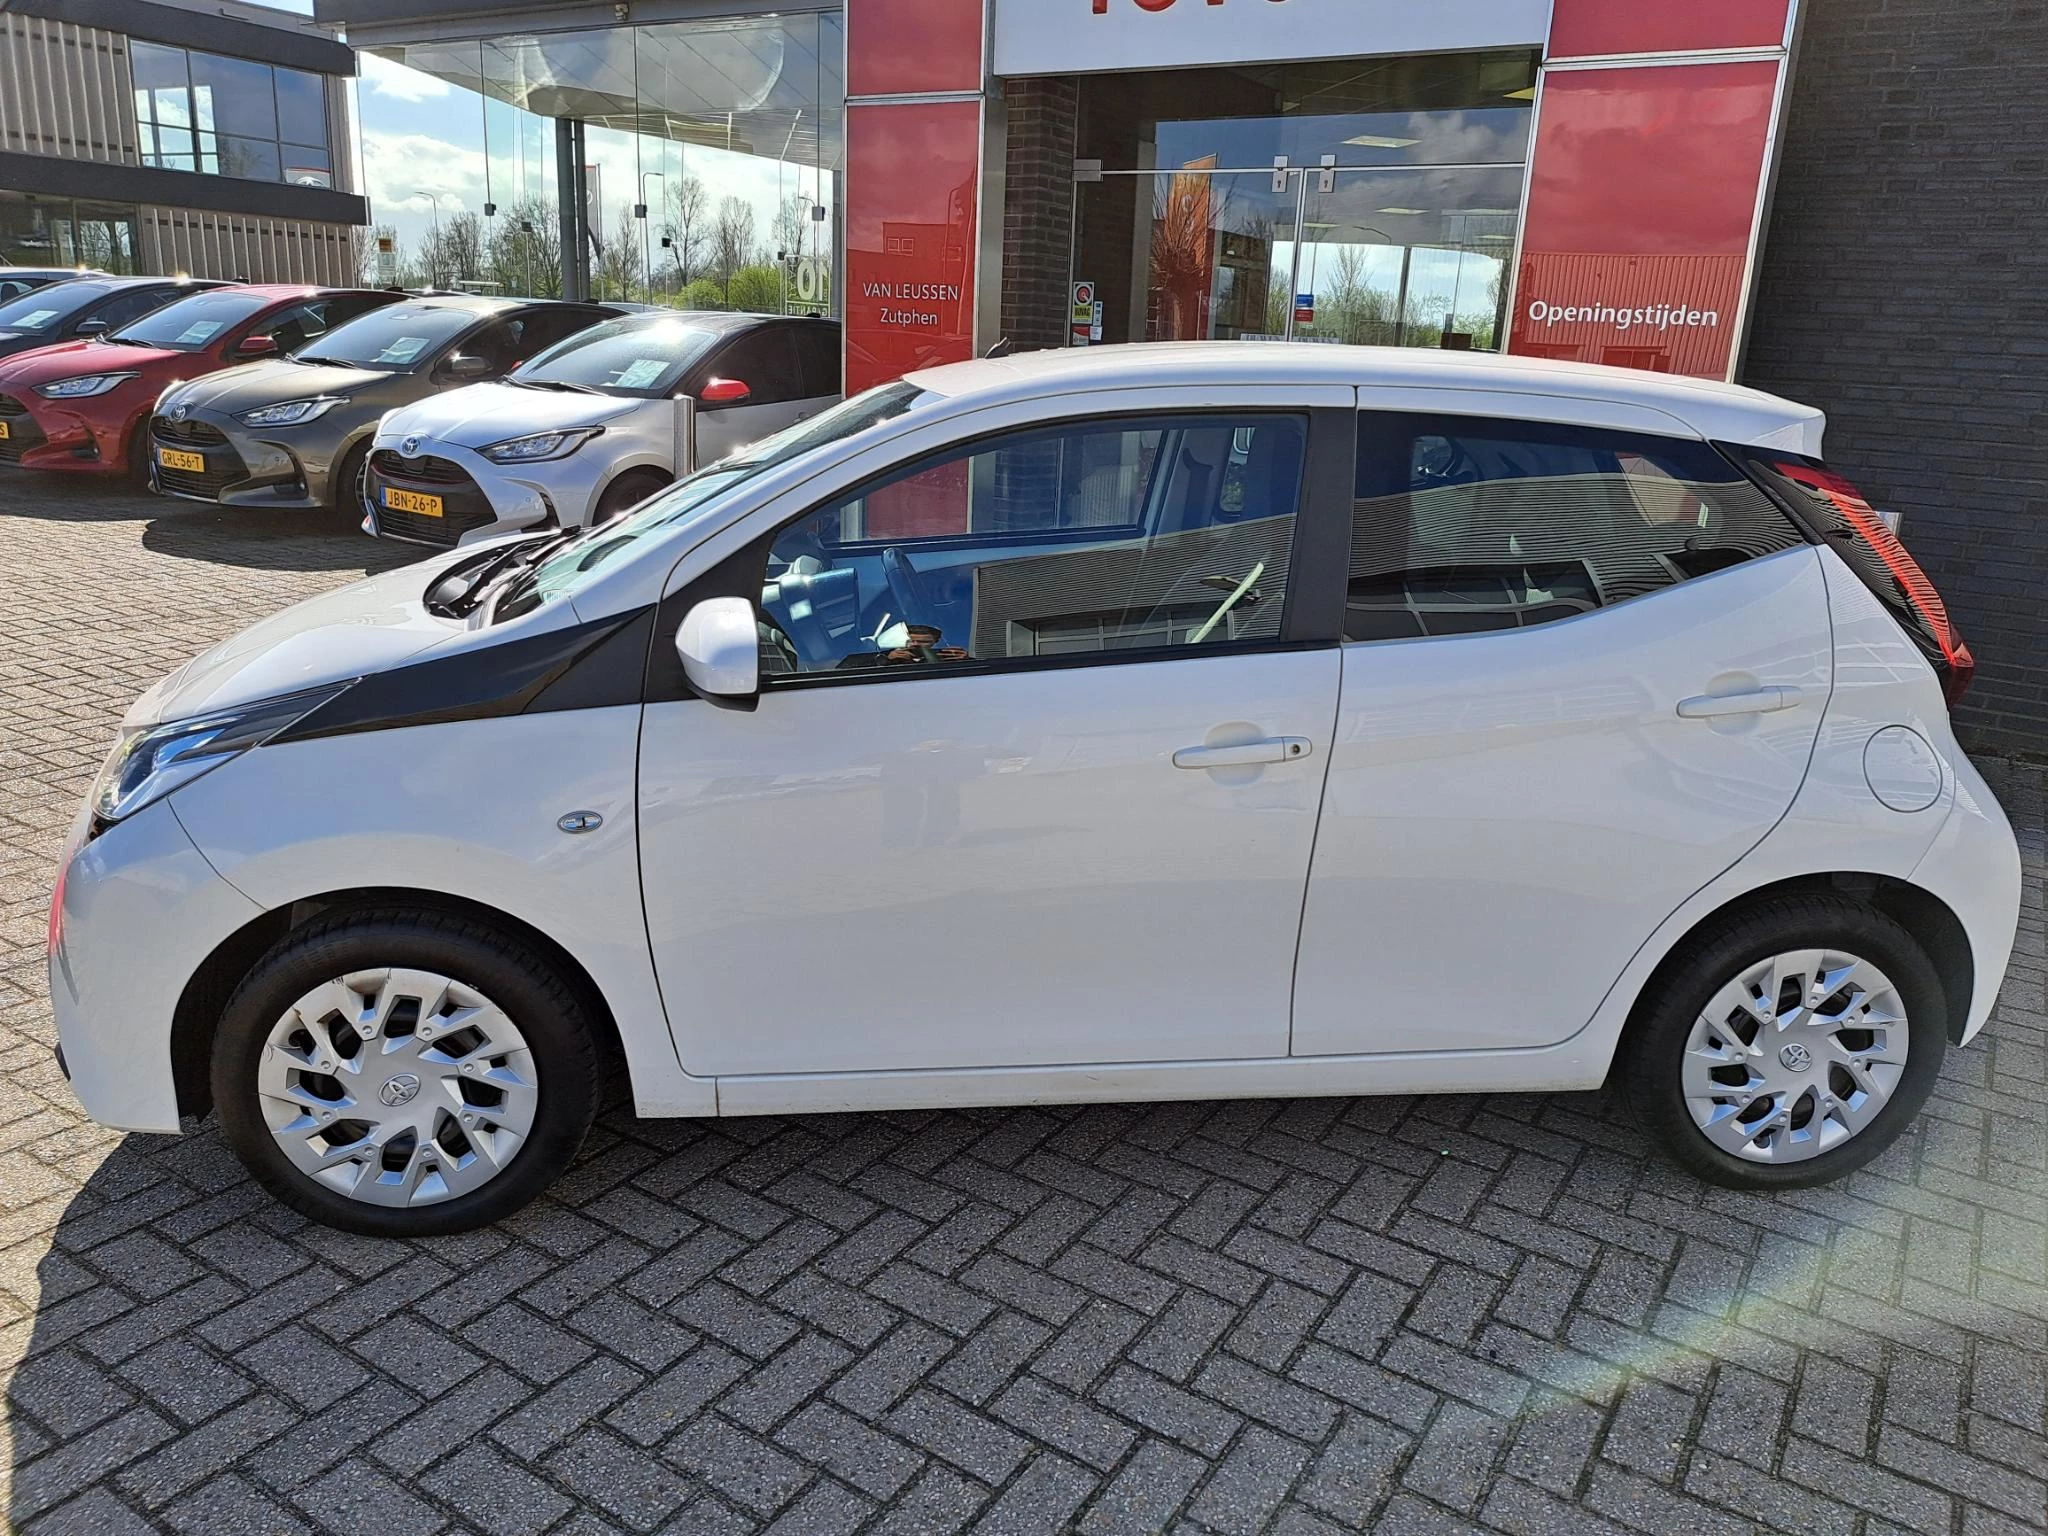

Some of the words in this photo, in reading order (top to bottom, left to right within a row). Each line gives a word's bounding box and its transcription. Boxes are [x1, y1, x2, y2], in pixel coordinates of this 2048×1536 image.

[862, 282, 891, 298] VAN
[895, 283, 958, 301] LEUSSEN
[880, 307, 938, 328] Zutphen
[1528, 300, 1718, 331] Openingstijden
[162, 451, 200, 470] GRL-56-T
[388, 490, 438, 513] JBN-26-P
